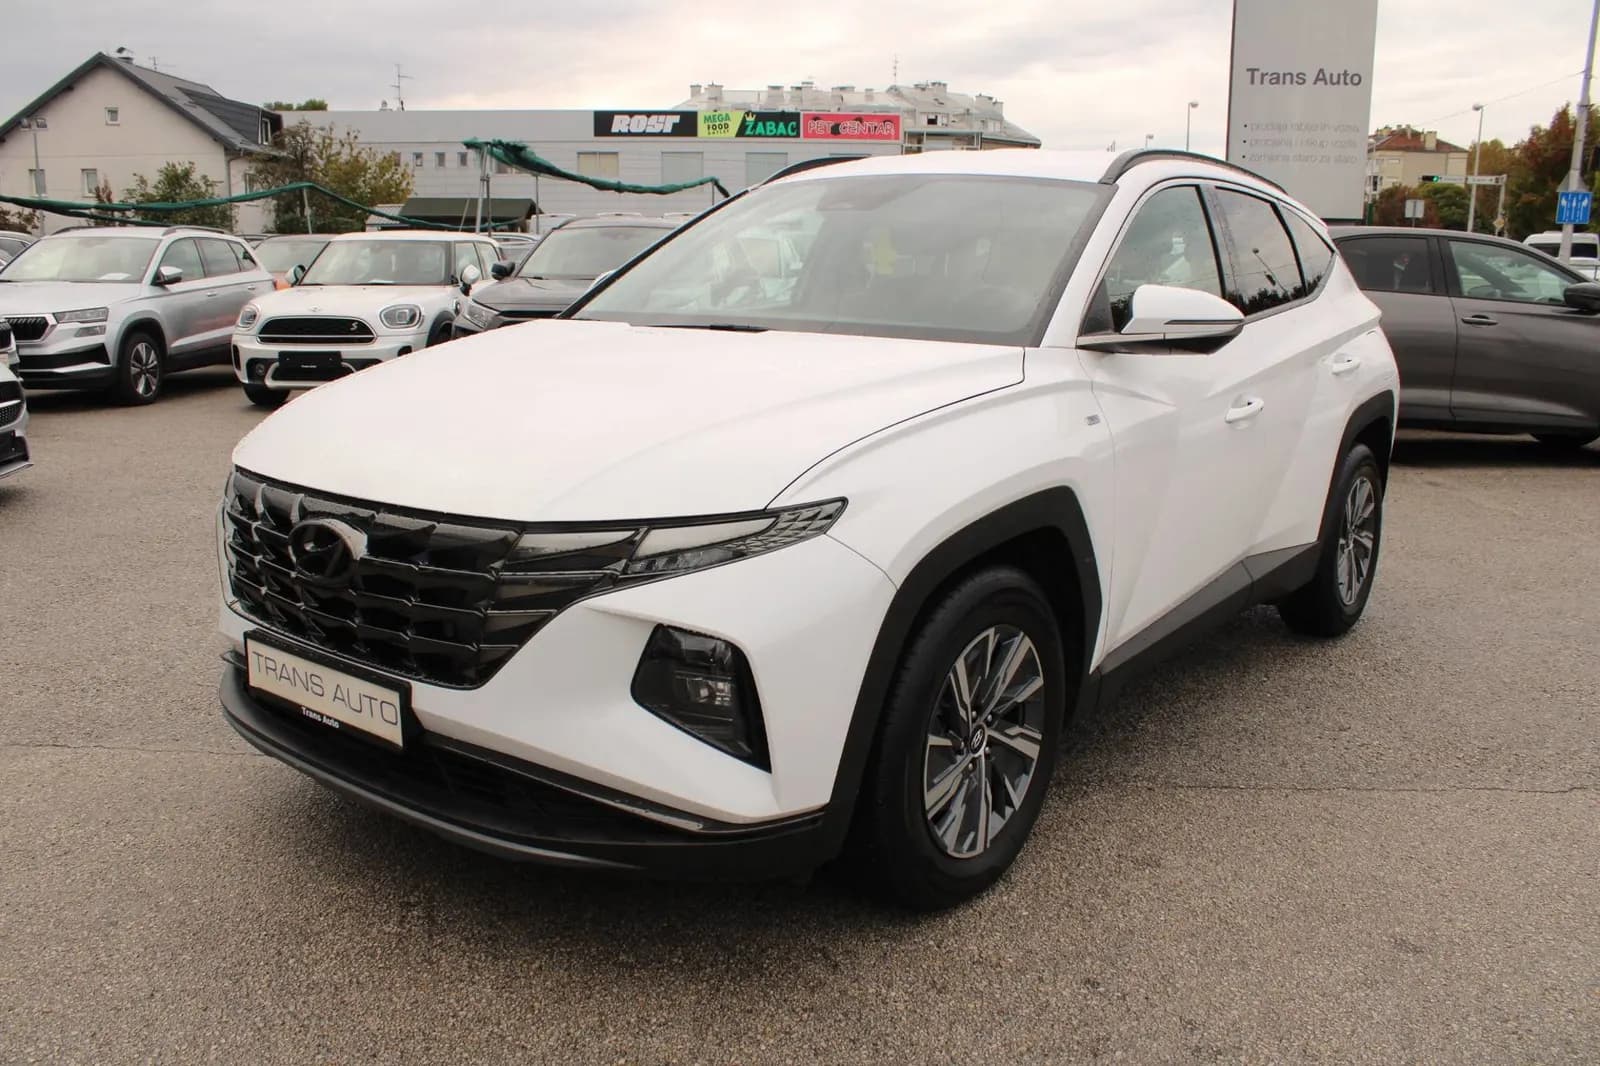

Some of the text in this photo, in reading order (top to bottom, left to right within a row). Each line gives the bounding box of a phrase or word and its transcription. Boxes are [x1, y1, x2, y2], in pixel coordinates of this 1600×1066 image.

[1246, 68, 1362, 86] Trans Auto
[703, 113, 731, 124] MEGA
[808, 120, 896, 136] PET CENTAR
[252, 651, 399, 726] TRANS AUTO
[301, 706, 340, 729] Trans Auto
